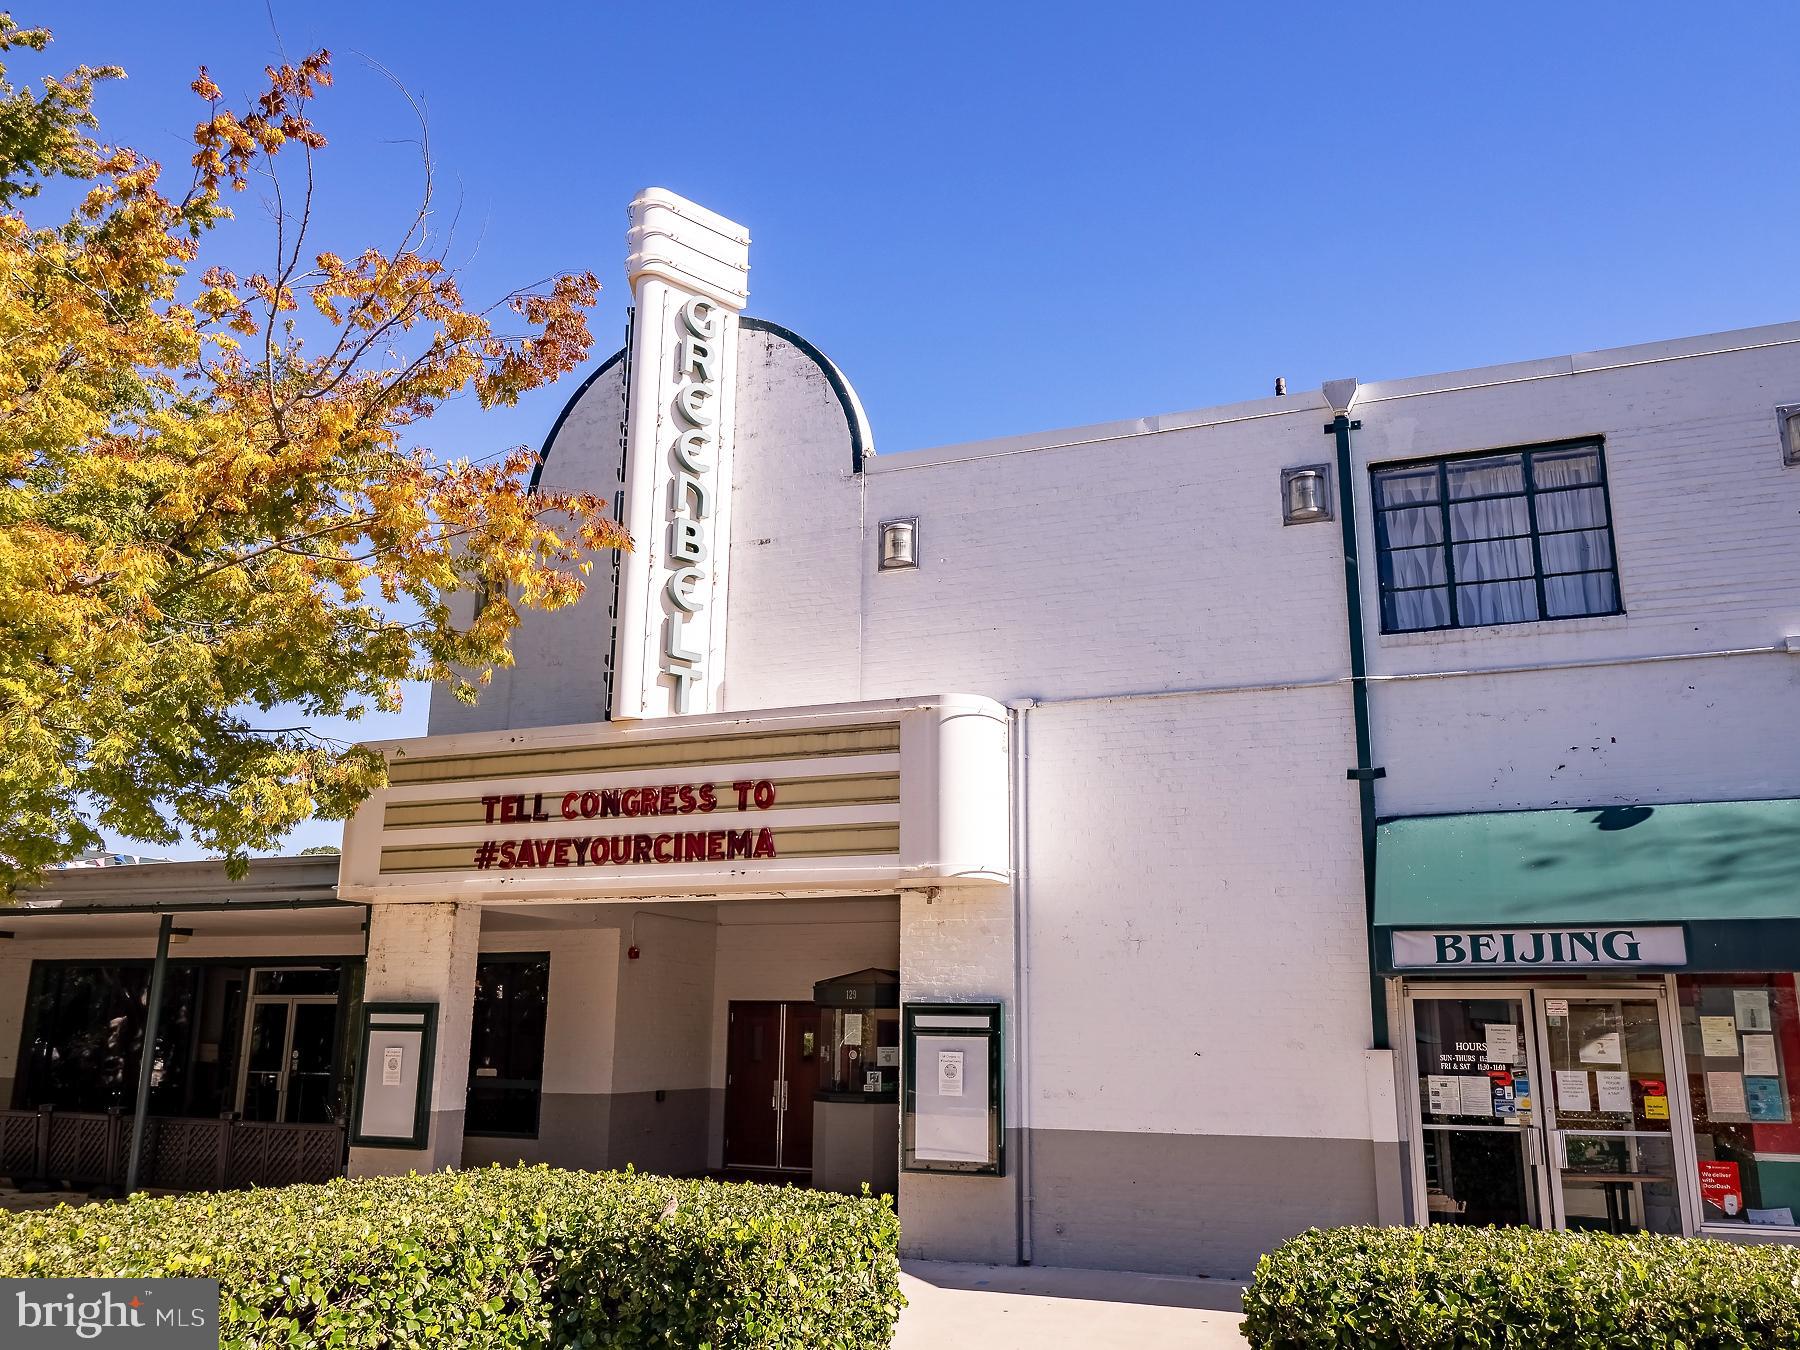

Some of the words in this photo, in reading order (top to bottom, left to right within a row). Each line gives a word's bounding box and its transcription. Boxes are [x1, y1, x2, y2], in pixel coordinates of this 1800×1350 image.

[666, 295, 717, 715] GREENBELT
[481, 794, 549, 824] TELL
[561, 782, 718, 820] CONGRESS
[733, 780, 776, 811] TO
[474, 827, 776, 870] #SAVEYOURCINEMA
[1433, 930, 1642, 963] BEIJING
[846, 989, 857, 1000] 129
[1439, 1054, 1476, 1062] SUN-THURS
[1455, 1042, 1488, 1051] HOURS
